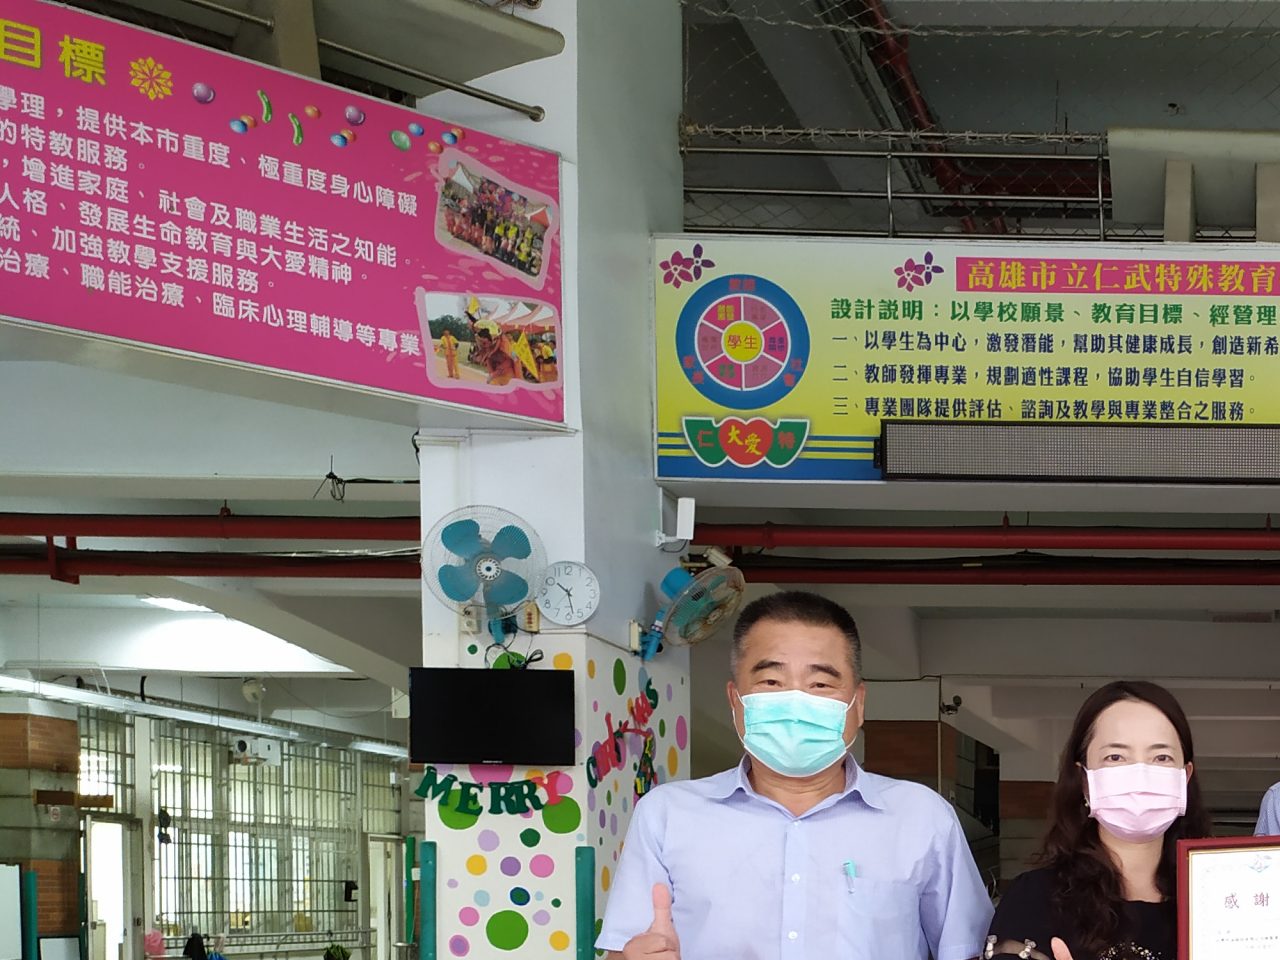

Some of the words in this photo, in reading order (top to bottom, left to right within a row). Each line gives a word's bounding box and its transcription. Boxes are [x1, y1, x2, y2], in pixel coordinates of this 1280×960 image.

[0, 19, 107, 86] 目標
[727, 334, 759, 350] 學生
[697, 430, 714, 448] 仁
[727, 424, 762, 456] 大愛
[414, 766, 564, 816] MERRY
